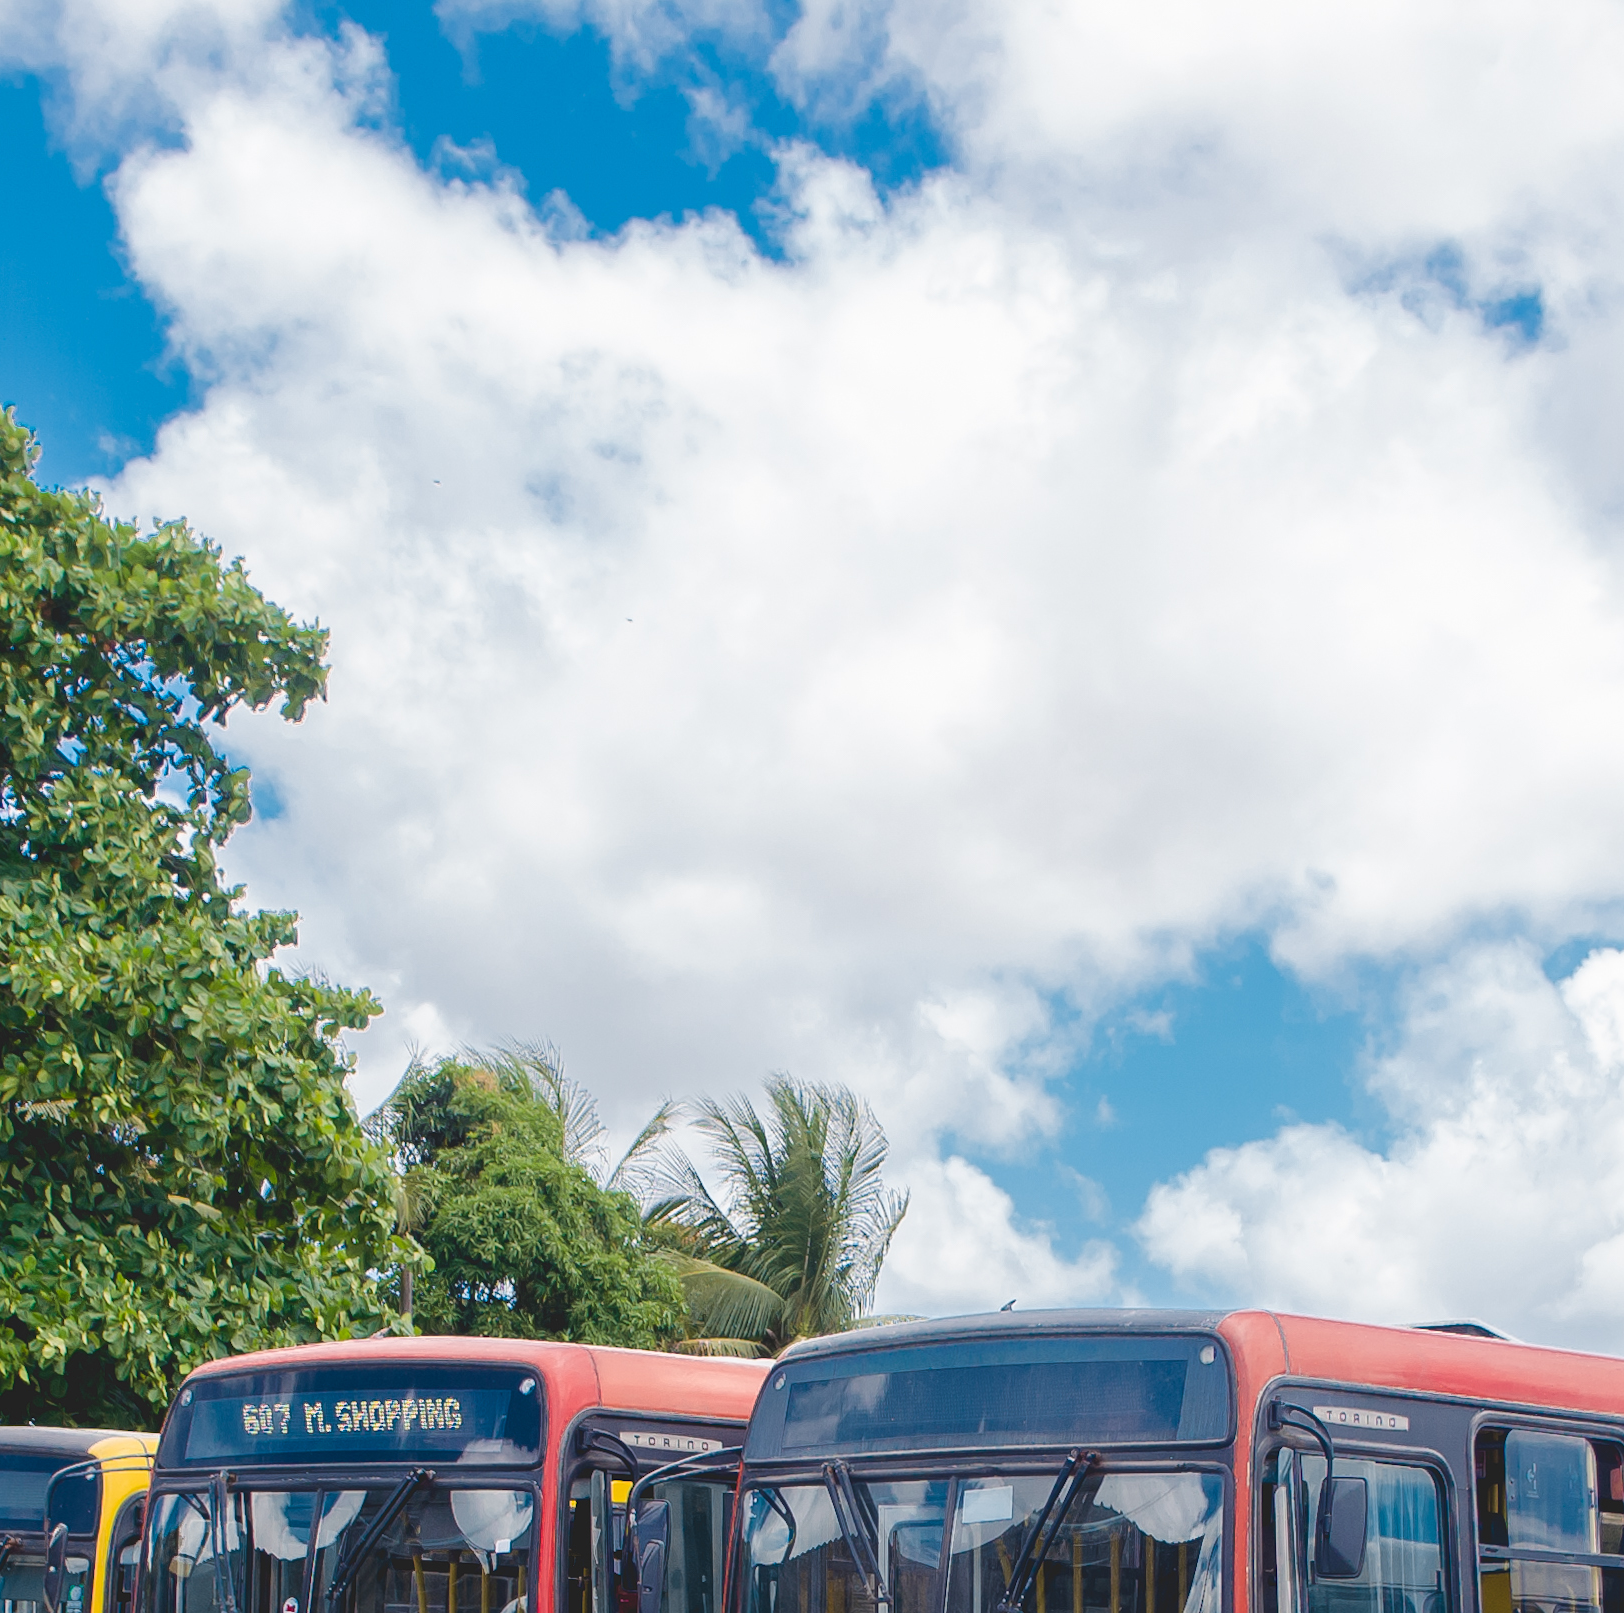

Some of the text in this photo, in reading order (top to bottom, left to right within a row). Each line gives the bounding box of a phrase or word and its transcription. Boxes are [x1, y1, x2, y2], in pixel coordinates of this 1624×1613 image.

[242, 1402, 292, 1435] 607
[1326, 1410, 1396, 1428] TORINO
[633, 1434, 710, 1451] TORINO
